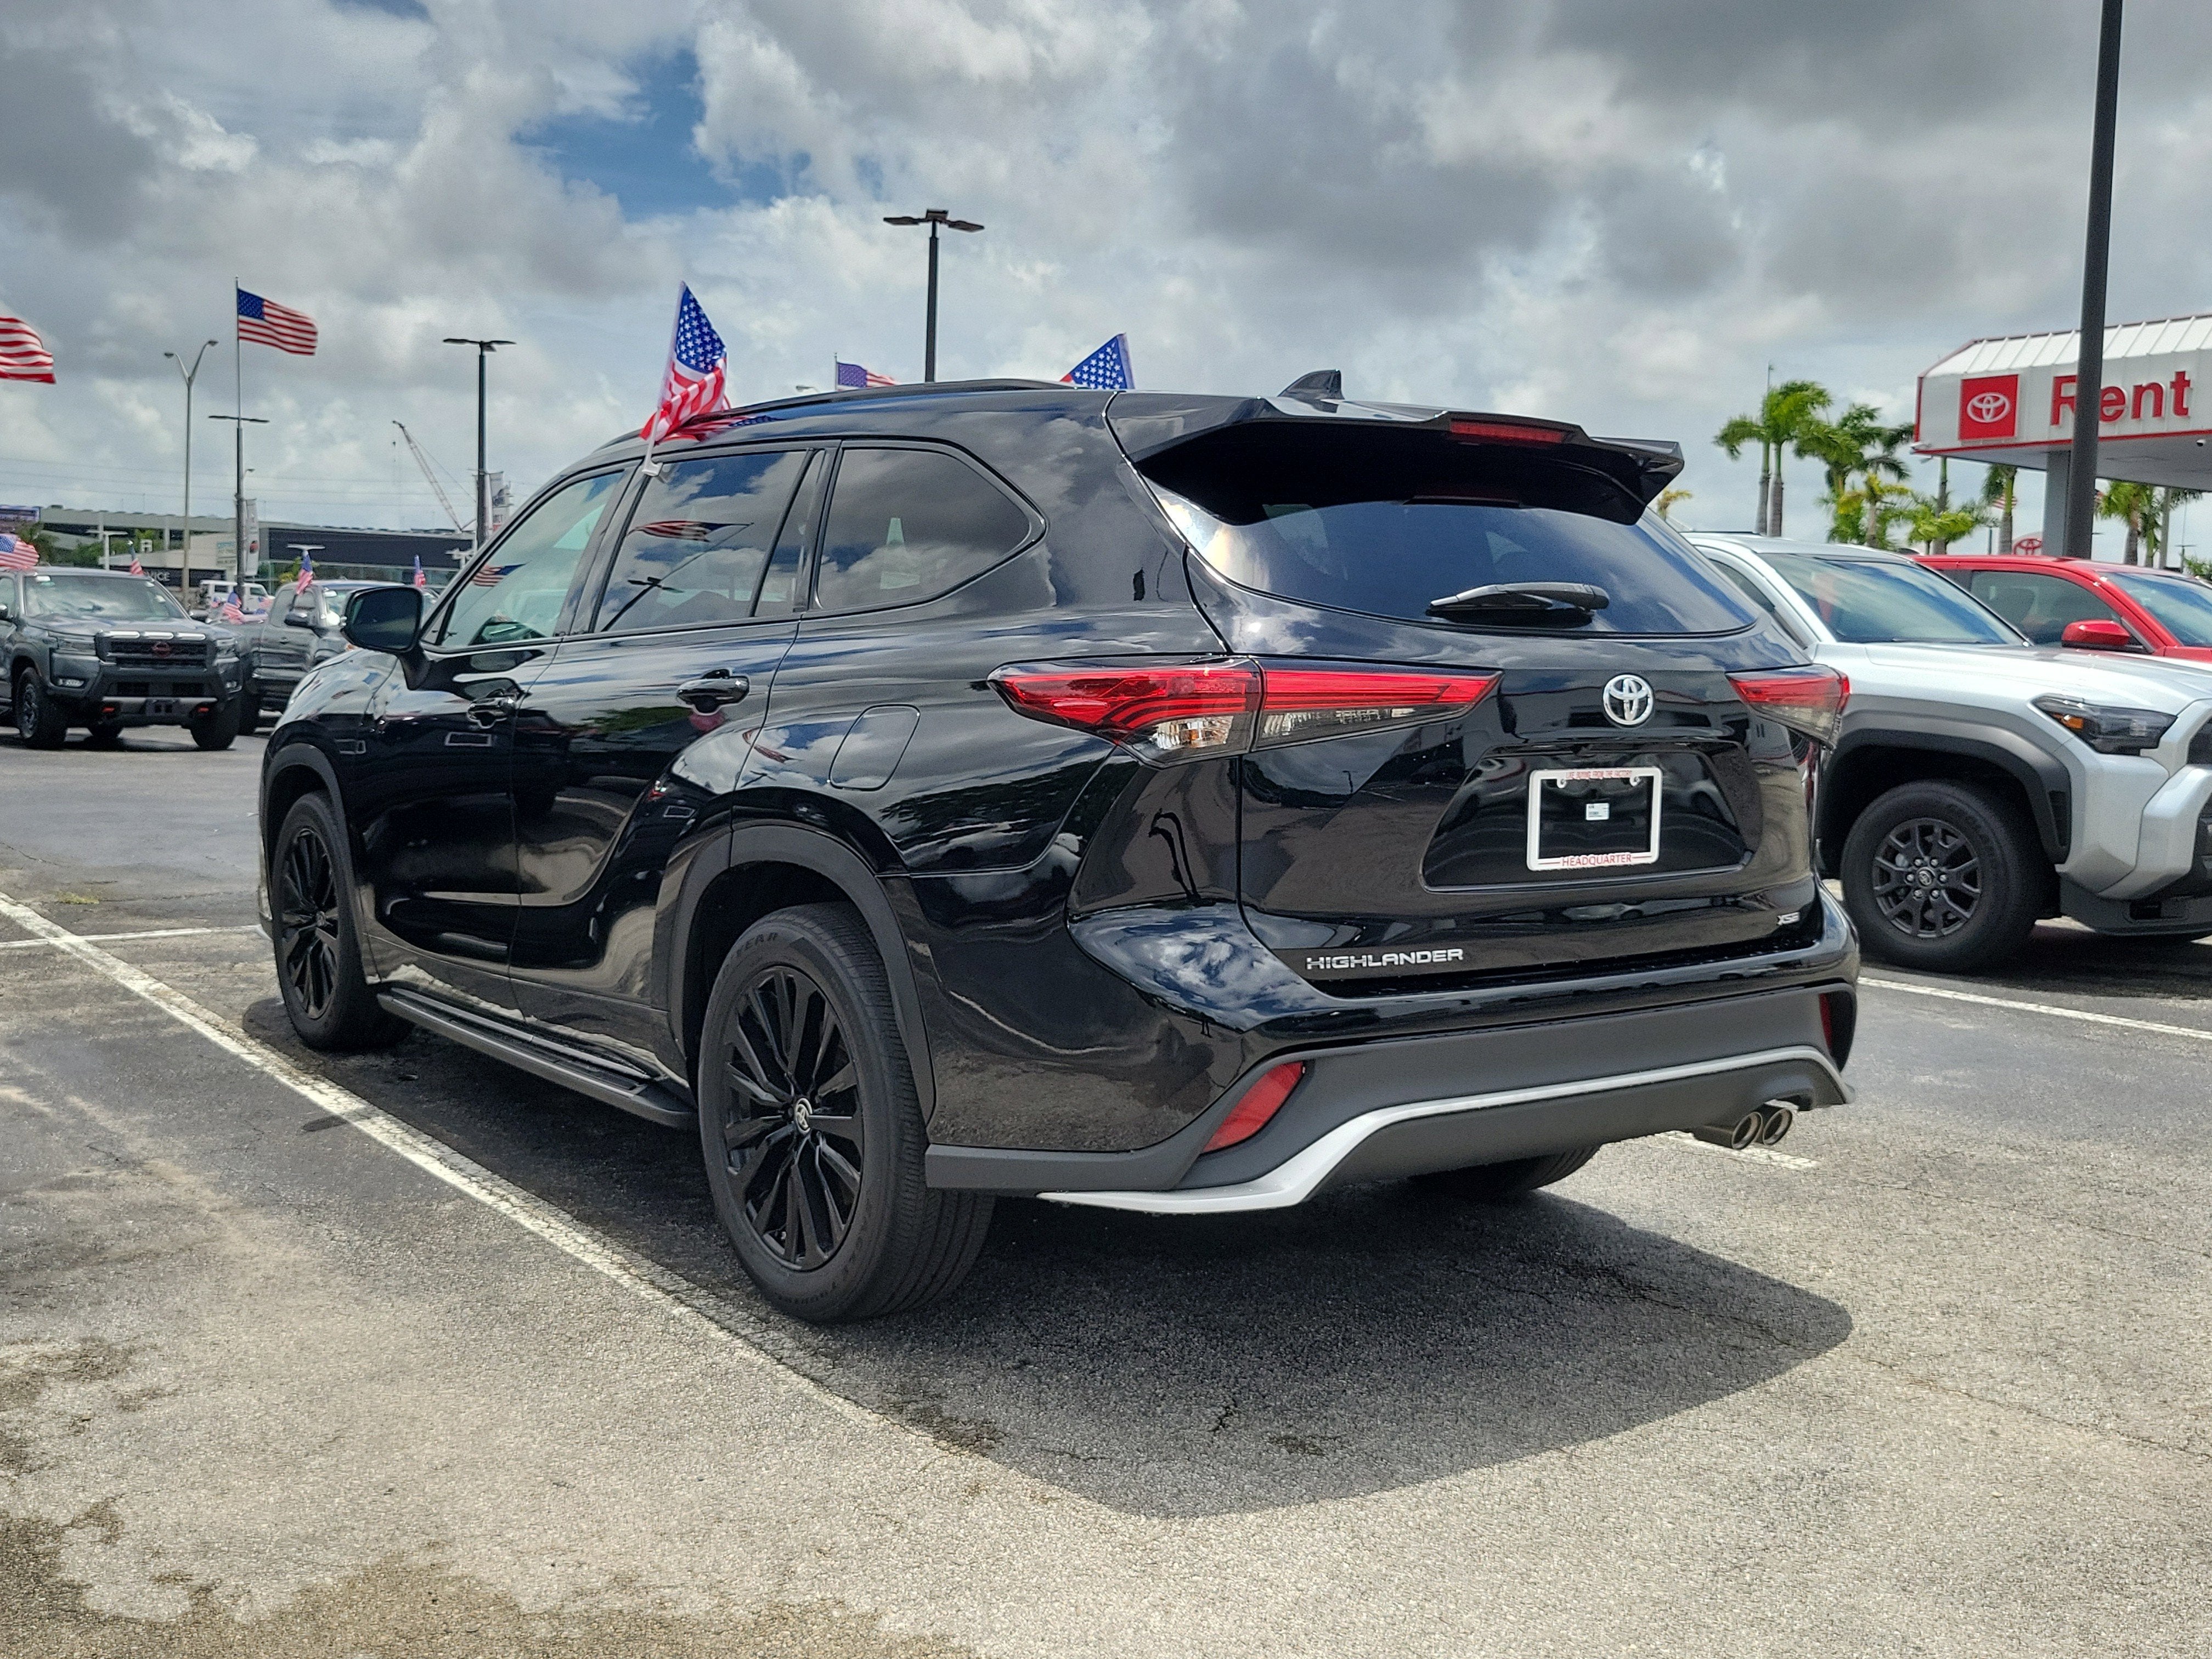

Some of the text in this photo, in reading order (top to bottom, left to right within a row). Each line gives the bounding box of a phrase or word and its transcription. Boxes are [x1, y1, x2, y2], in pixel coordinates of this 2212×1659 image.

[2050, 371, 2191, 425] Rent
[1562, 854, 1632, 867] HEADQUARTER
[1306, 948, 1464, 970] HIGHLANDER
